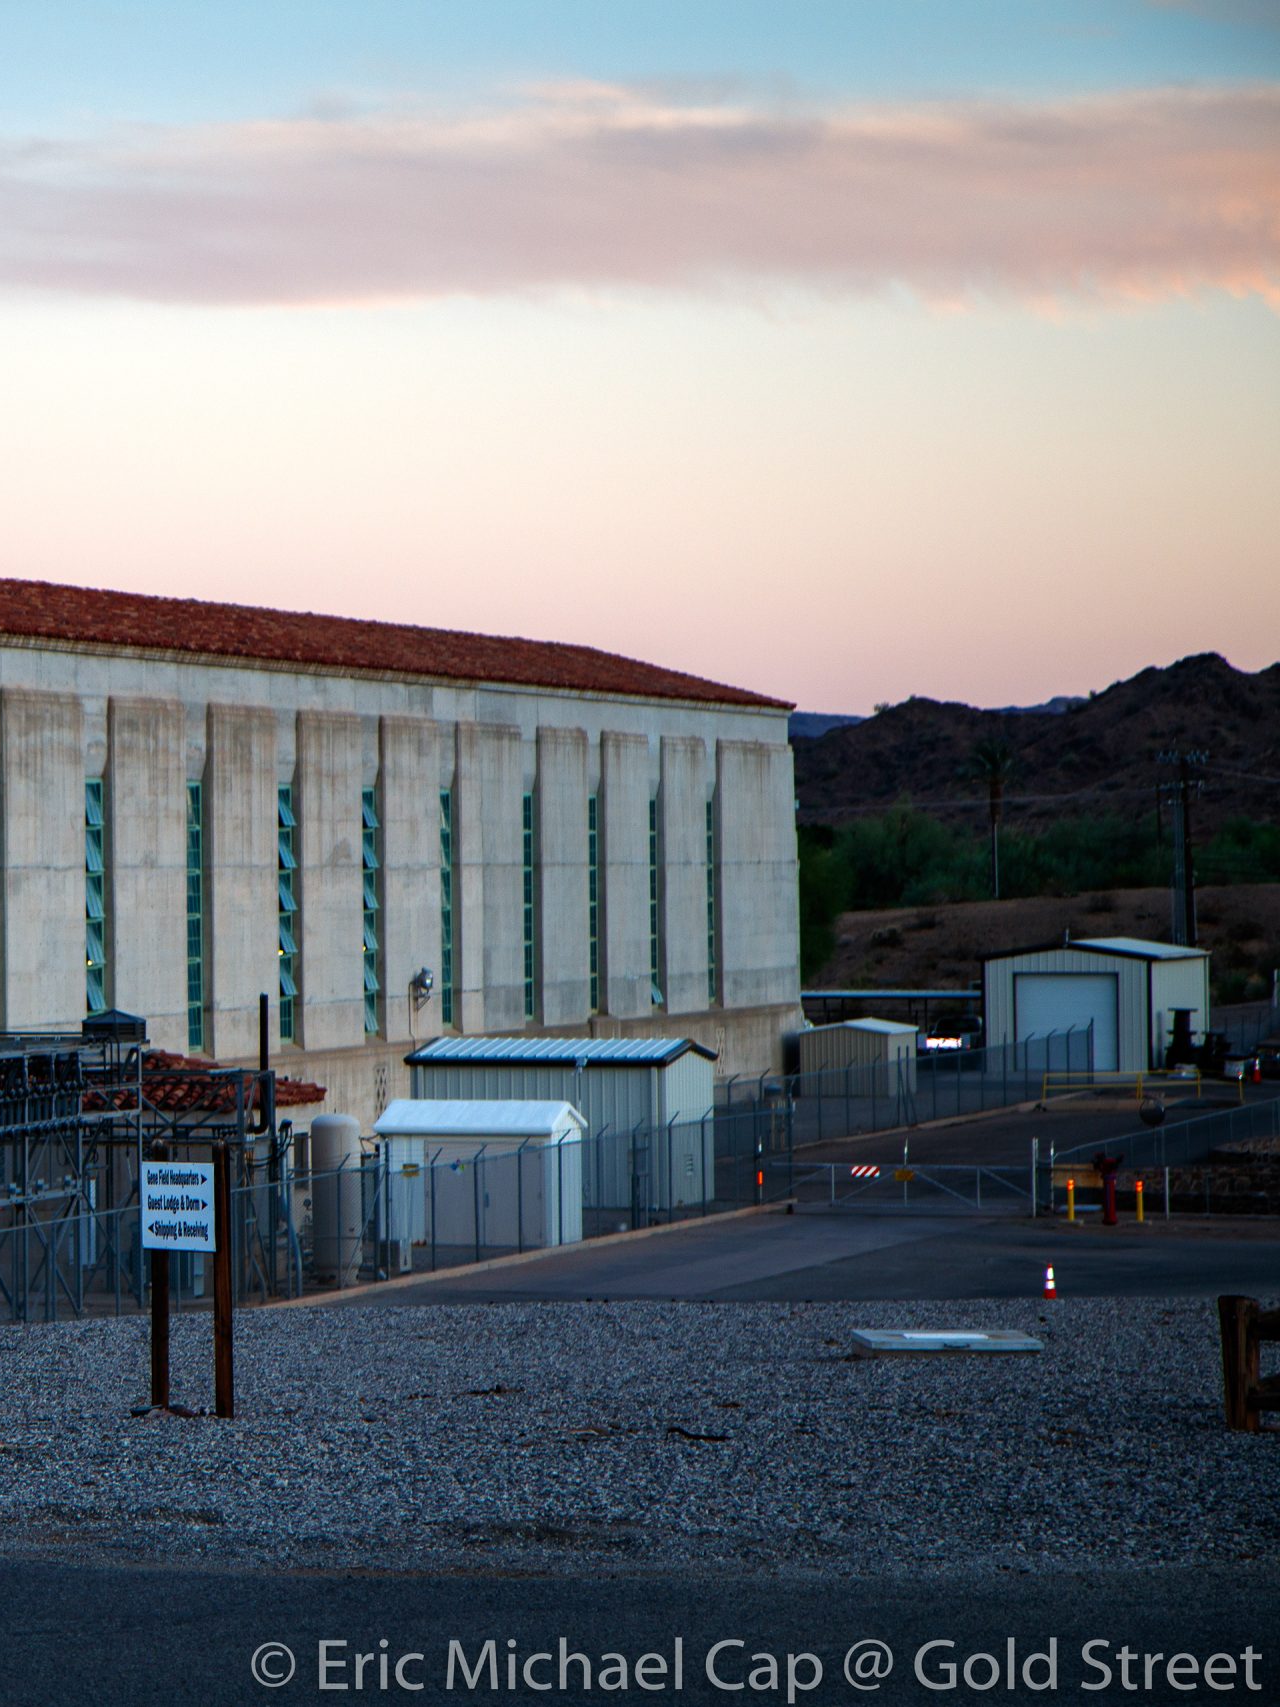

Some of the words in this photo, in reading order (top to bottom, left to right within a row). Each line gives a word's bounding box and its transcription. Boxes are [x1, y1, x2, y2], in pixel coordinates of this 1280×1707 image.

[147, 1169, 158, 1185] Gene
[159, 1170, 169, 1185] Field
[170, 1170, 199, 1188] Headquarters
[148, 1194, 163, 1210] Guest
[163, 1195, 179, 1214] Lodge
[181, 1195, 185, 1210] &
[186, 1195, 200, 1211] Dorm
[154, 1220, 177, 1240] Shipping
[178, 1221, 183, 1237] &
[183, 1221, 209, 1241] Receiving
